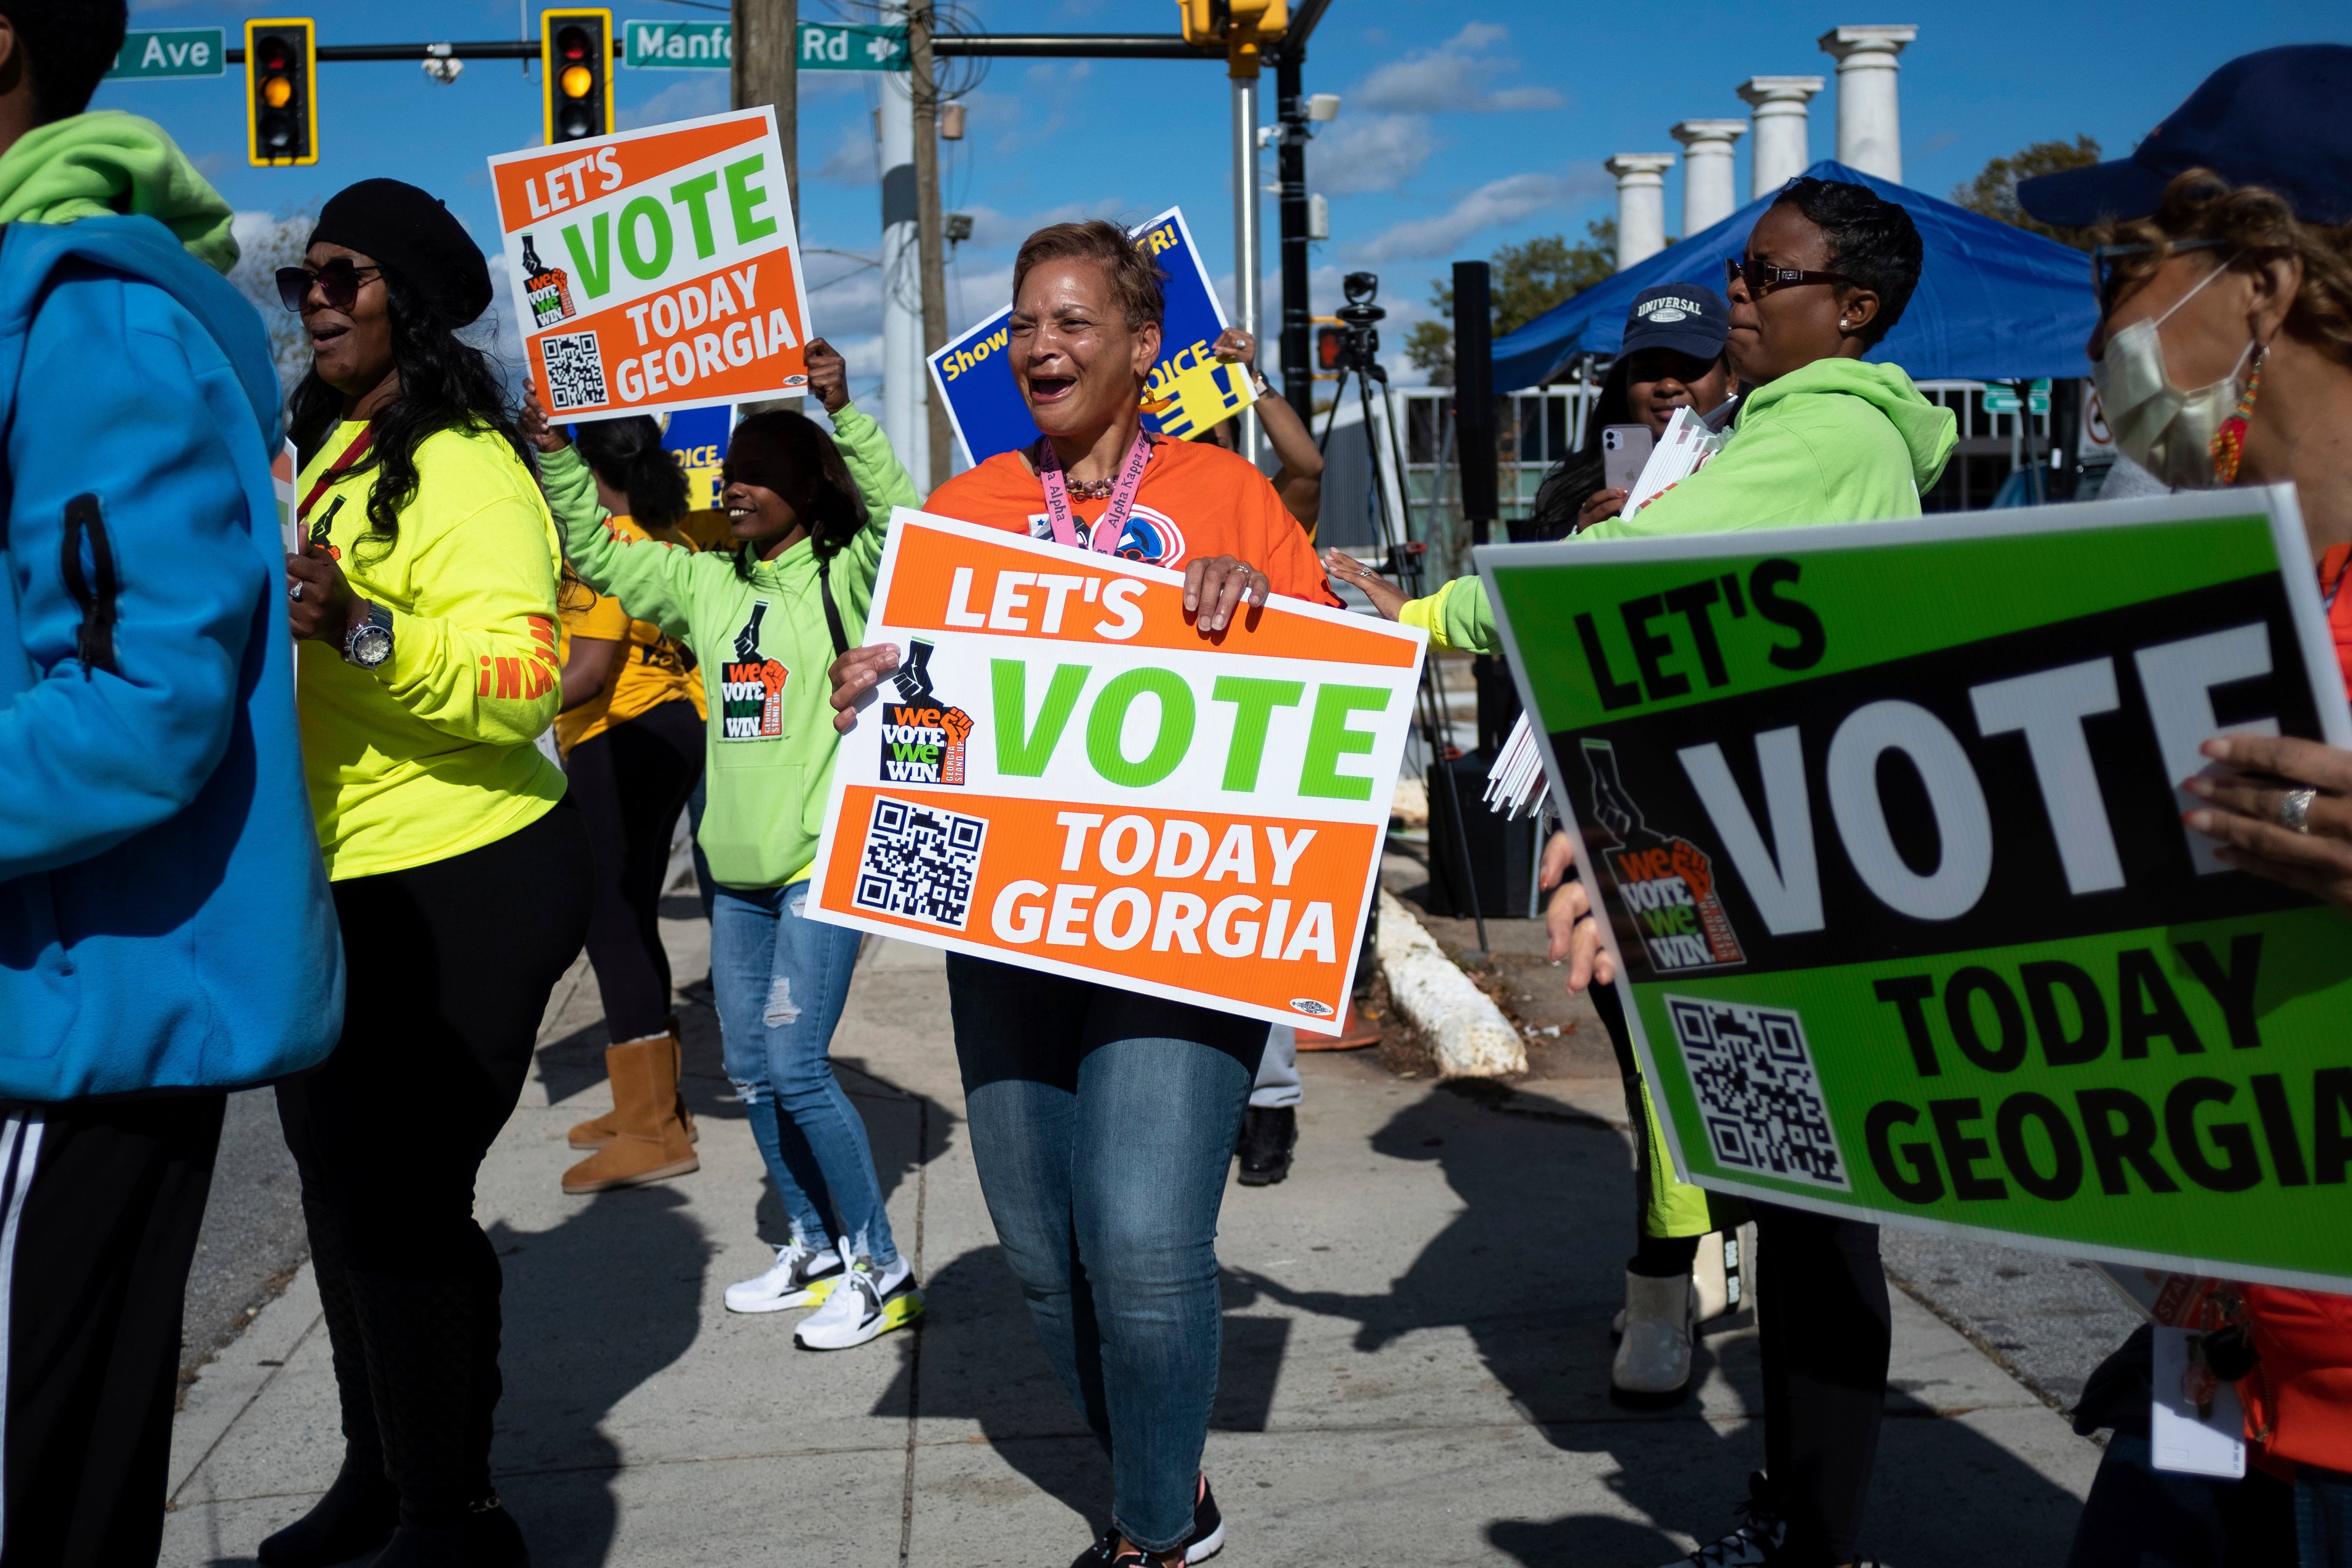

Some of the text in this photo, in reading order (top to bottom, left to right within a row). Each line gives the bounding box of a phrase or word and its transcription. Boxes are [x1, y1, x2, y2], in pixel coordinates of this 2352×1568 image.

[141, 35, 210, 69] Ave
[804, 29, 848, 61] Rd
[526, 146, 623, 219] LET'S
[561, 153, 777, 300] VOTE
[528, 273, 552, 292] we
[626, 264, 758, 346] TODAY
[1638, 296, 1702, 317] UNIVERSAL
[616, 308, 799, 402] GEORGIA
[942, 327, 1008, 382] Show
[1143, 339, 1210, 393] OICE
[1049, 486, 1065, 522] Alpha
[1108, 492, 1129, 529] Alpha
[1121, 453, 1145, 489] Kappa
[945, 567, 1148, 640] LET'S
[1574, 558, 1826, 711] LET'S
[729, 663, 761, 683] we
[726, 717, 761, 737] WIN.
[730, 700, 760, 718] we
[894, 707, 941, 728] we
[990, 658, 1393, 801] VOTE
[886, 760, 941, 783] WIN.
[892, 743, 939, 764] we
[946, 745, 956, 781] GEORGIA
[1677, 621, 2282, 935] VOTE
[1056, 811, 1318, 886] TODAY
[1618, 847, 1674, 882] we
[991, 880, 1337, 963] GEORGIA
[1642, 904, 1698, 938] we
[1649, 932, 1716, 968] WIN.
[1873, 932, 2263, 1077] TODAY
